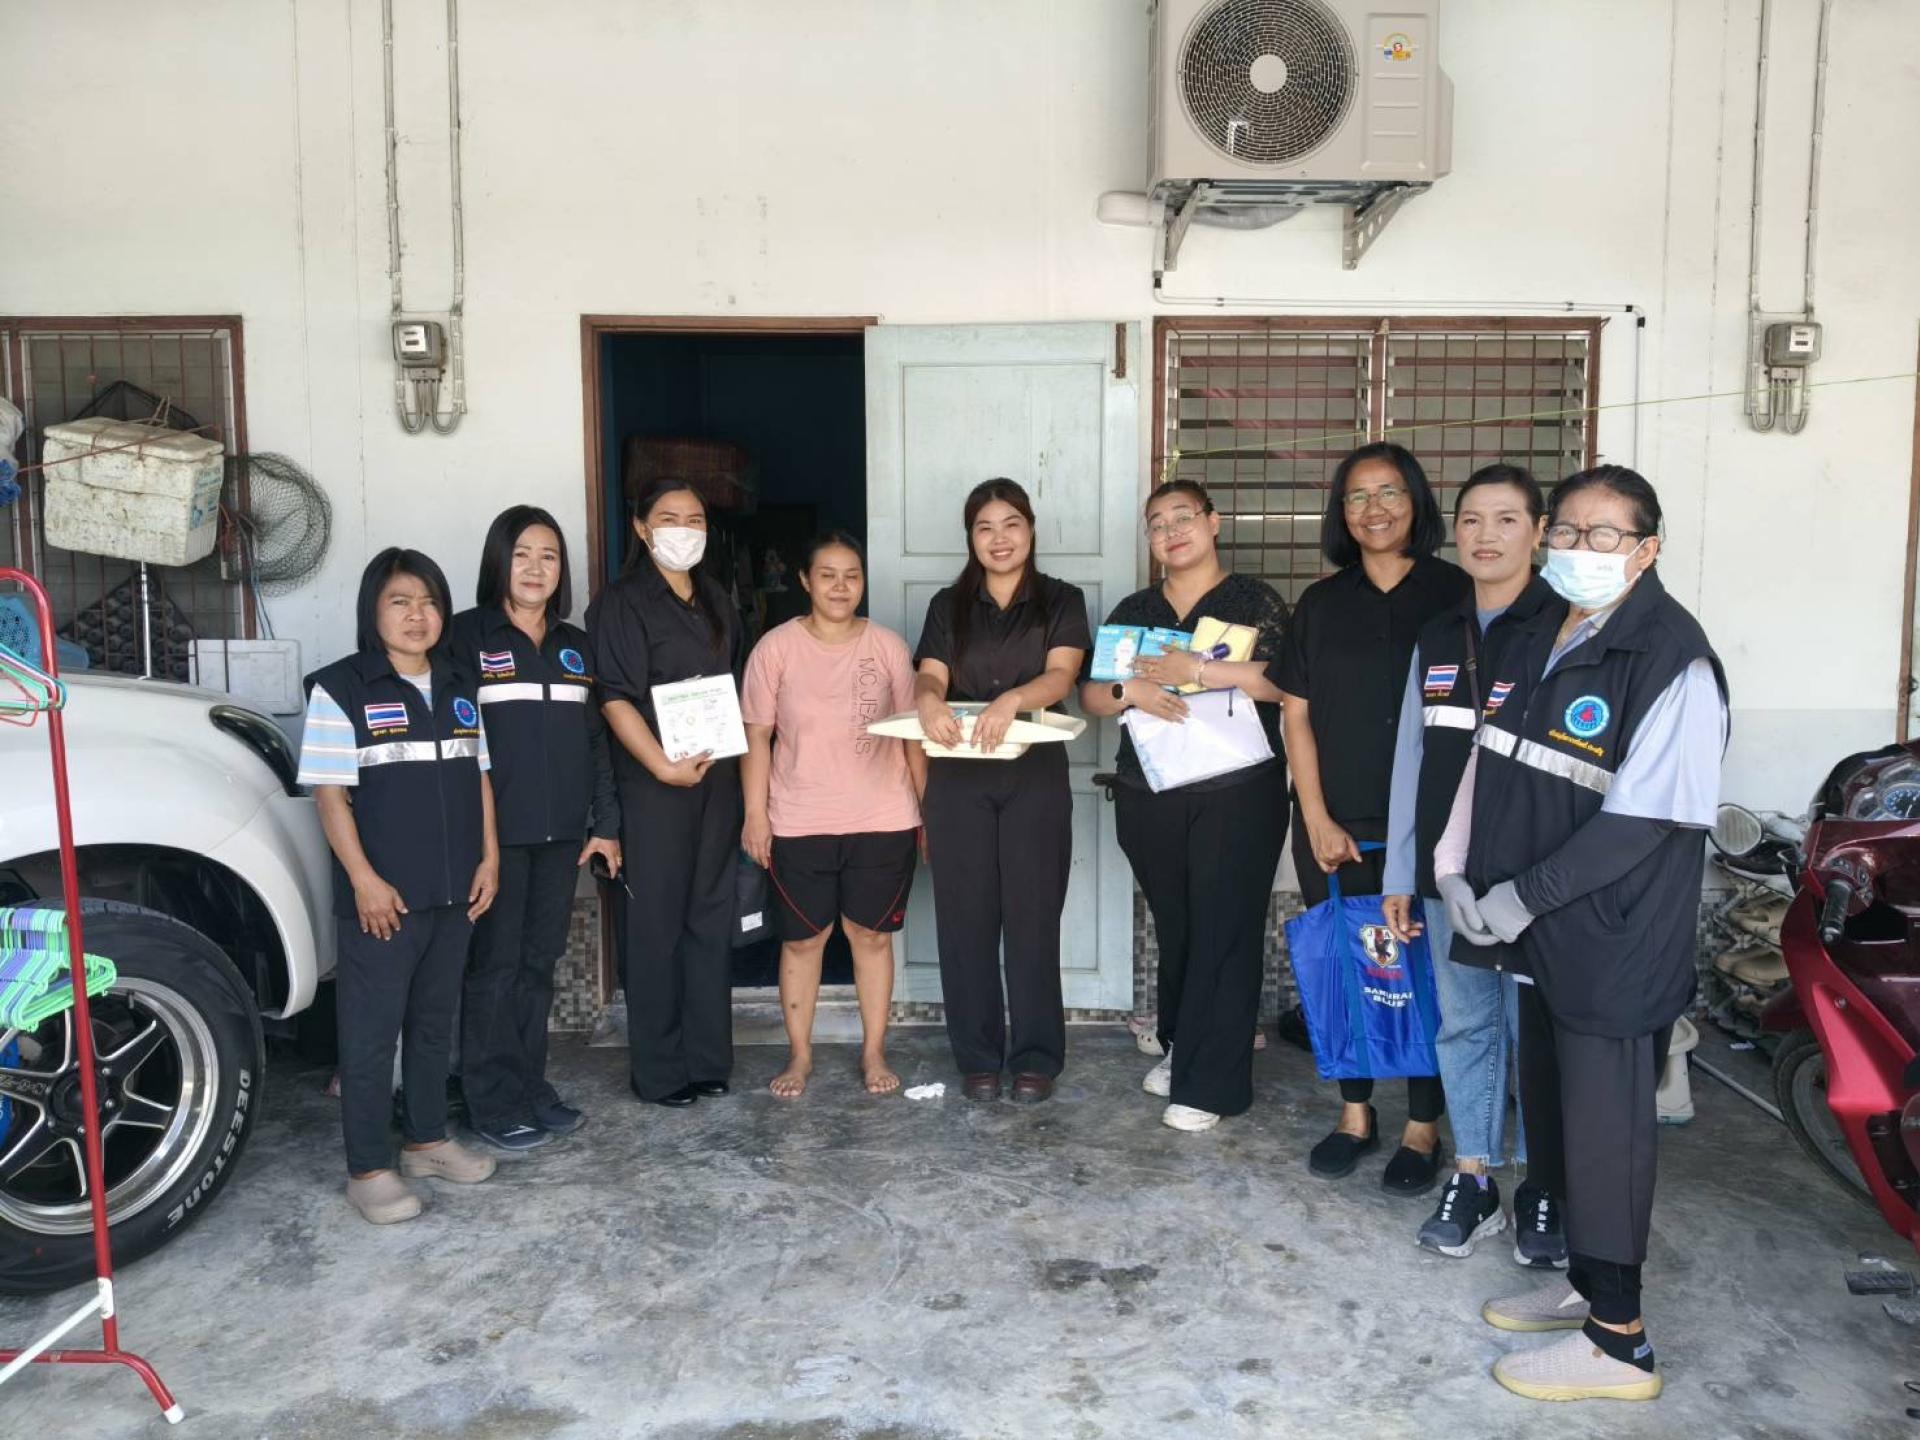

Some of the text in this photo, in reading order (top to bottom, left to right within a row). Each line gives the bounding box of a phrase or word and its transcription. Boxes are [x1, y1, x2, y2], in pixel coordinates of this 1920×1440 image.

[855, 657, 877, 754] MC JEANS
[1364, 986, 1413, 1000] SAMURAI
[1373, 995, 1406, 1007] BLUE
[168, 1069, 250, 1229] DEESTONE
